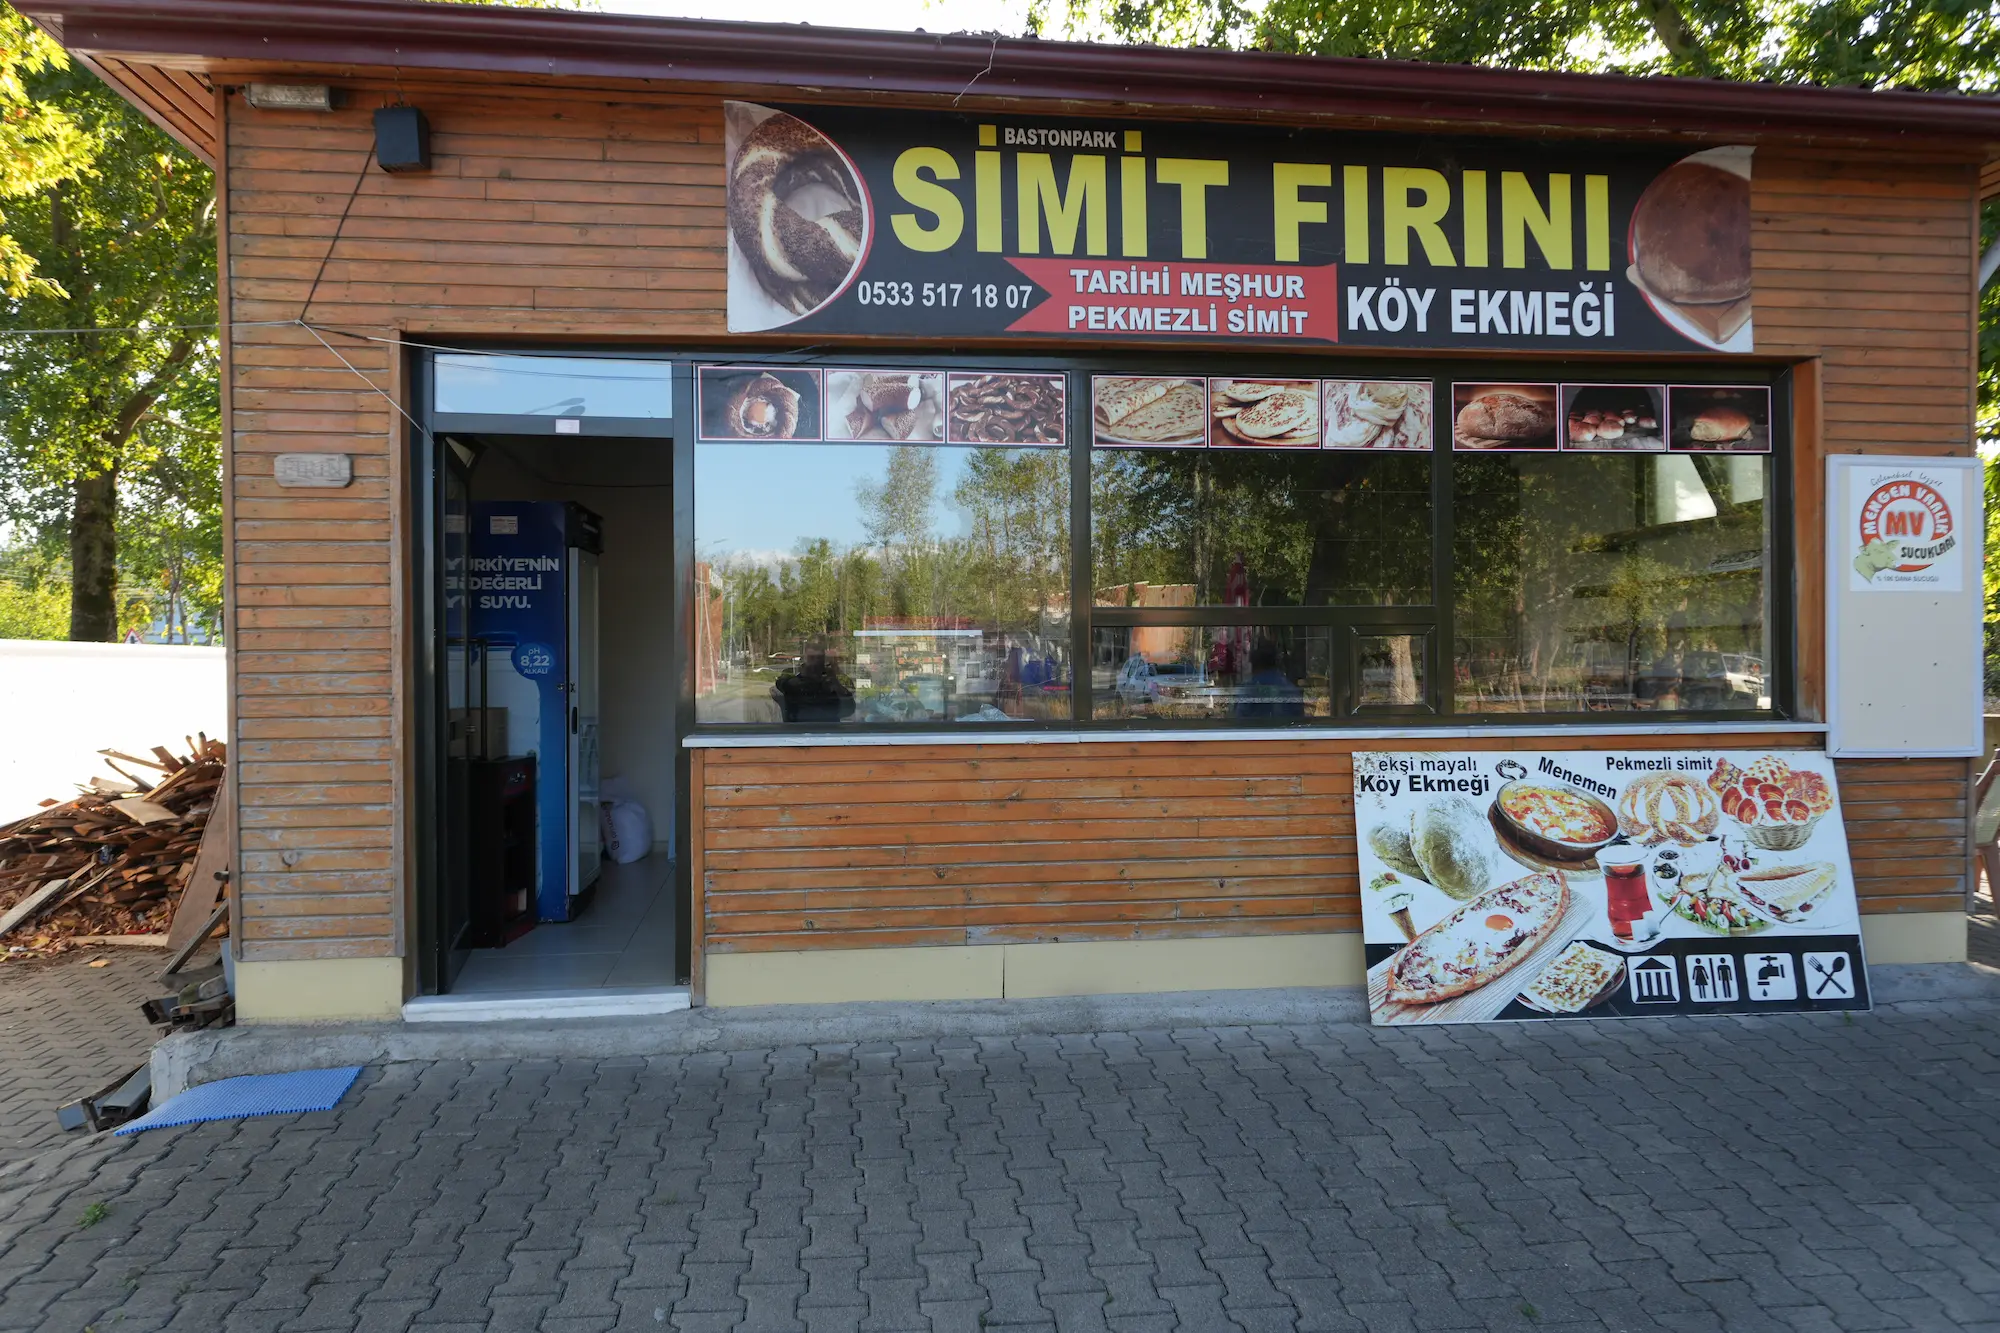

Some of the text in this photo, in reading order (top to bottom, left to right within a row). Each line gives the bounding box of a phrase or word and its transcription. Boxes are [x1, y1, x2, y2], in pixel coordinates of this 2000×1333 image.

[1003, 127, 1117, 148] BASTONPARK
[890, 124, 1611, 271] SİMİT FIRINI
[857, 281, 1033, 309] 0533 517 18 07
[1069, 265, 1305, 303] TARİHİ MEŞHUR
[1068, 303, 1309, 334] PEKMEZLİ SİMİT
[1347, 277, 1616, 338] KÖY EKMEĞİ
[1863, 484, 1911, 535] MENGEN
[1885, 510, 1925, 536] MV
[1901, 535, 1956, 560] SUCUKLARI
[480, 595, 532, 609] SUYU.
[520, 655, 550, 668] 8,22
[528, 646, 541, 657] pH
[1378, 757, 1477, 775] ekşi mayalı
[1606, 757, 1713, 771] Pekmezli simit
[1360, 774, 1490, 796] Köy Ekmeği
[1537, 756, 1617, 800] Menemen
